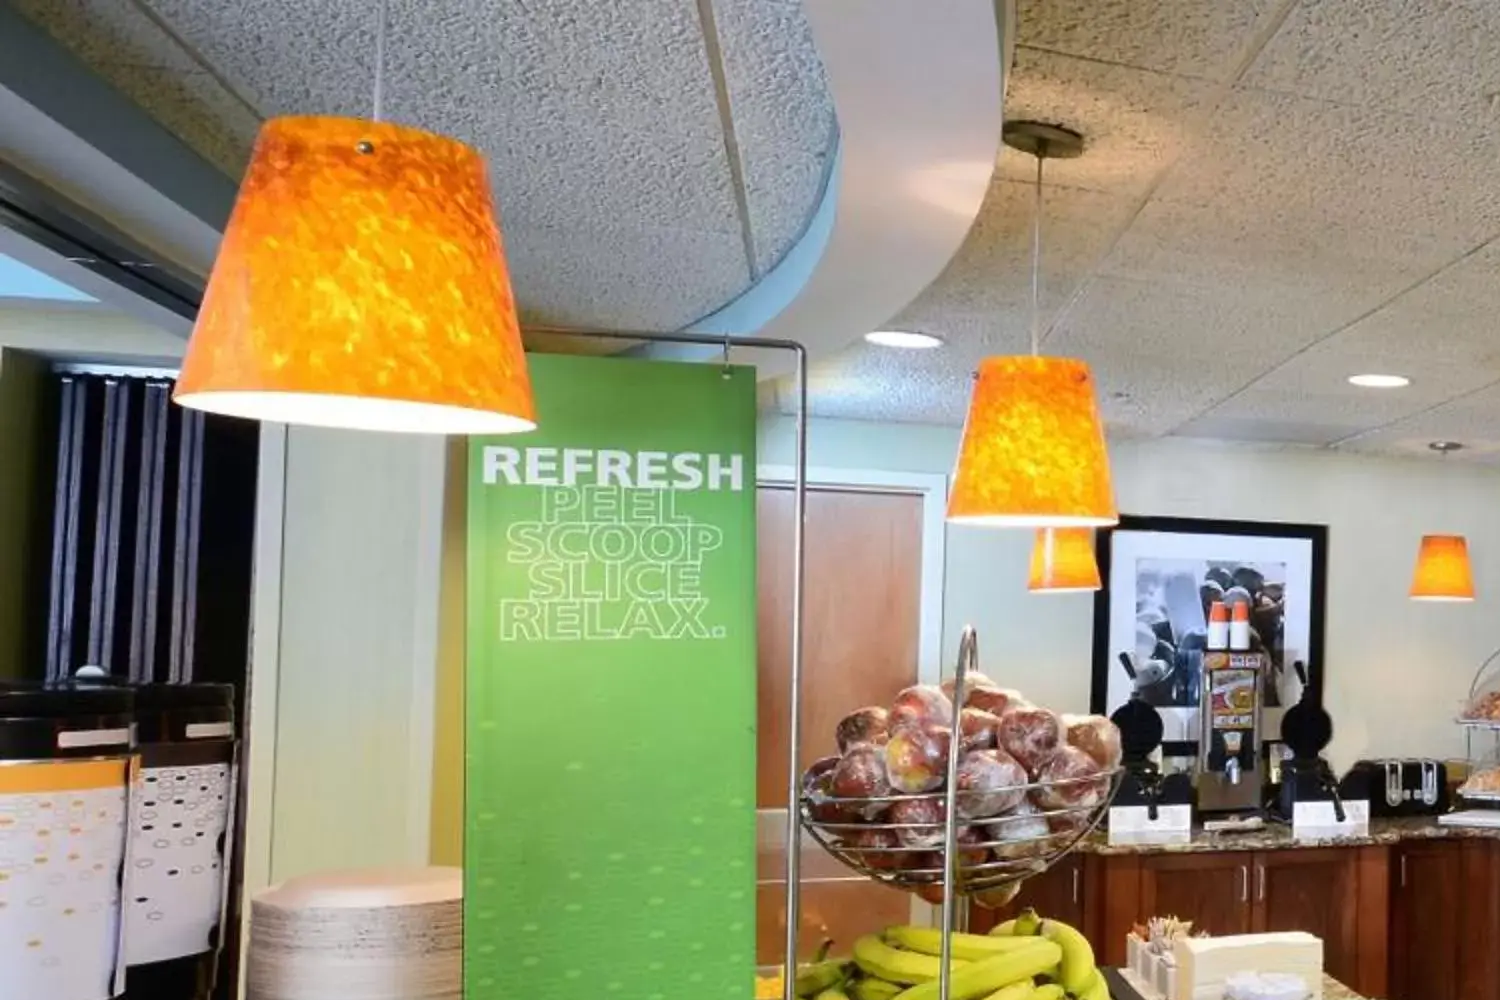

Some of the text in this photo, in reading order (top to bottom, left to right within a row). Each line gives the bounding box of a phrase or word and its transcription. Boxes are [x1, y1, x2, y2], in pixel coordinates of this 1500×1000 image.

[483, 446, 743, 490] REFRESH
[541, 484, 690, 525] PEEL
[506, 521, 723, 564] SCOOP
[528, 560, 702, 602] SLICE
[500, 597, 726, 641] RELAX.
